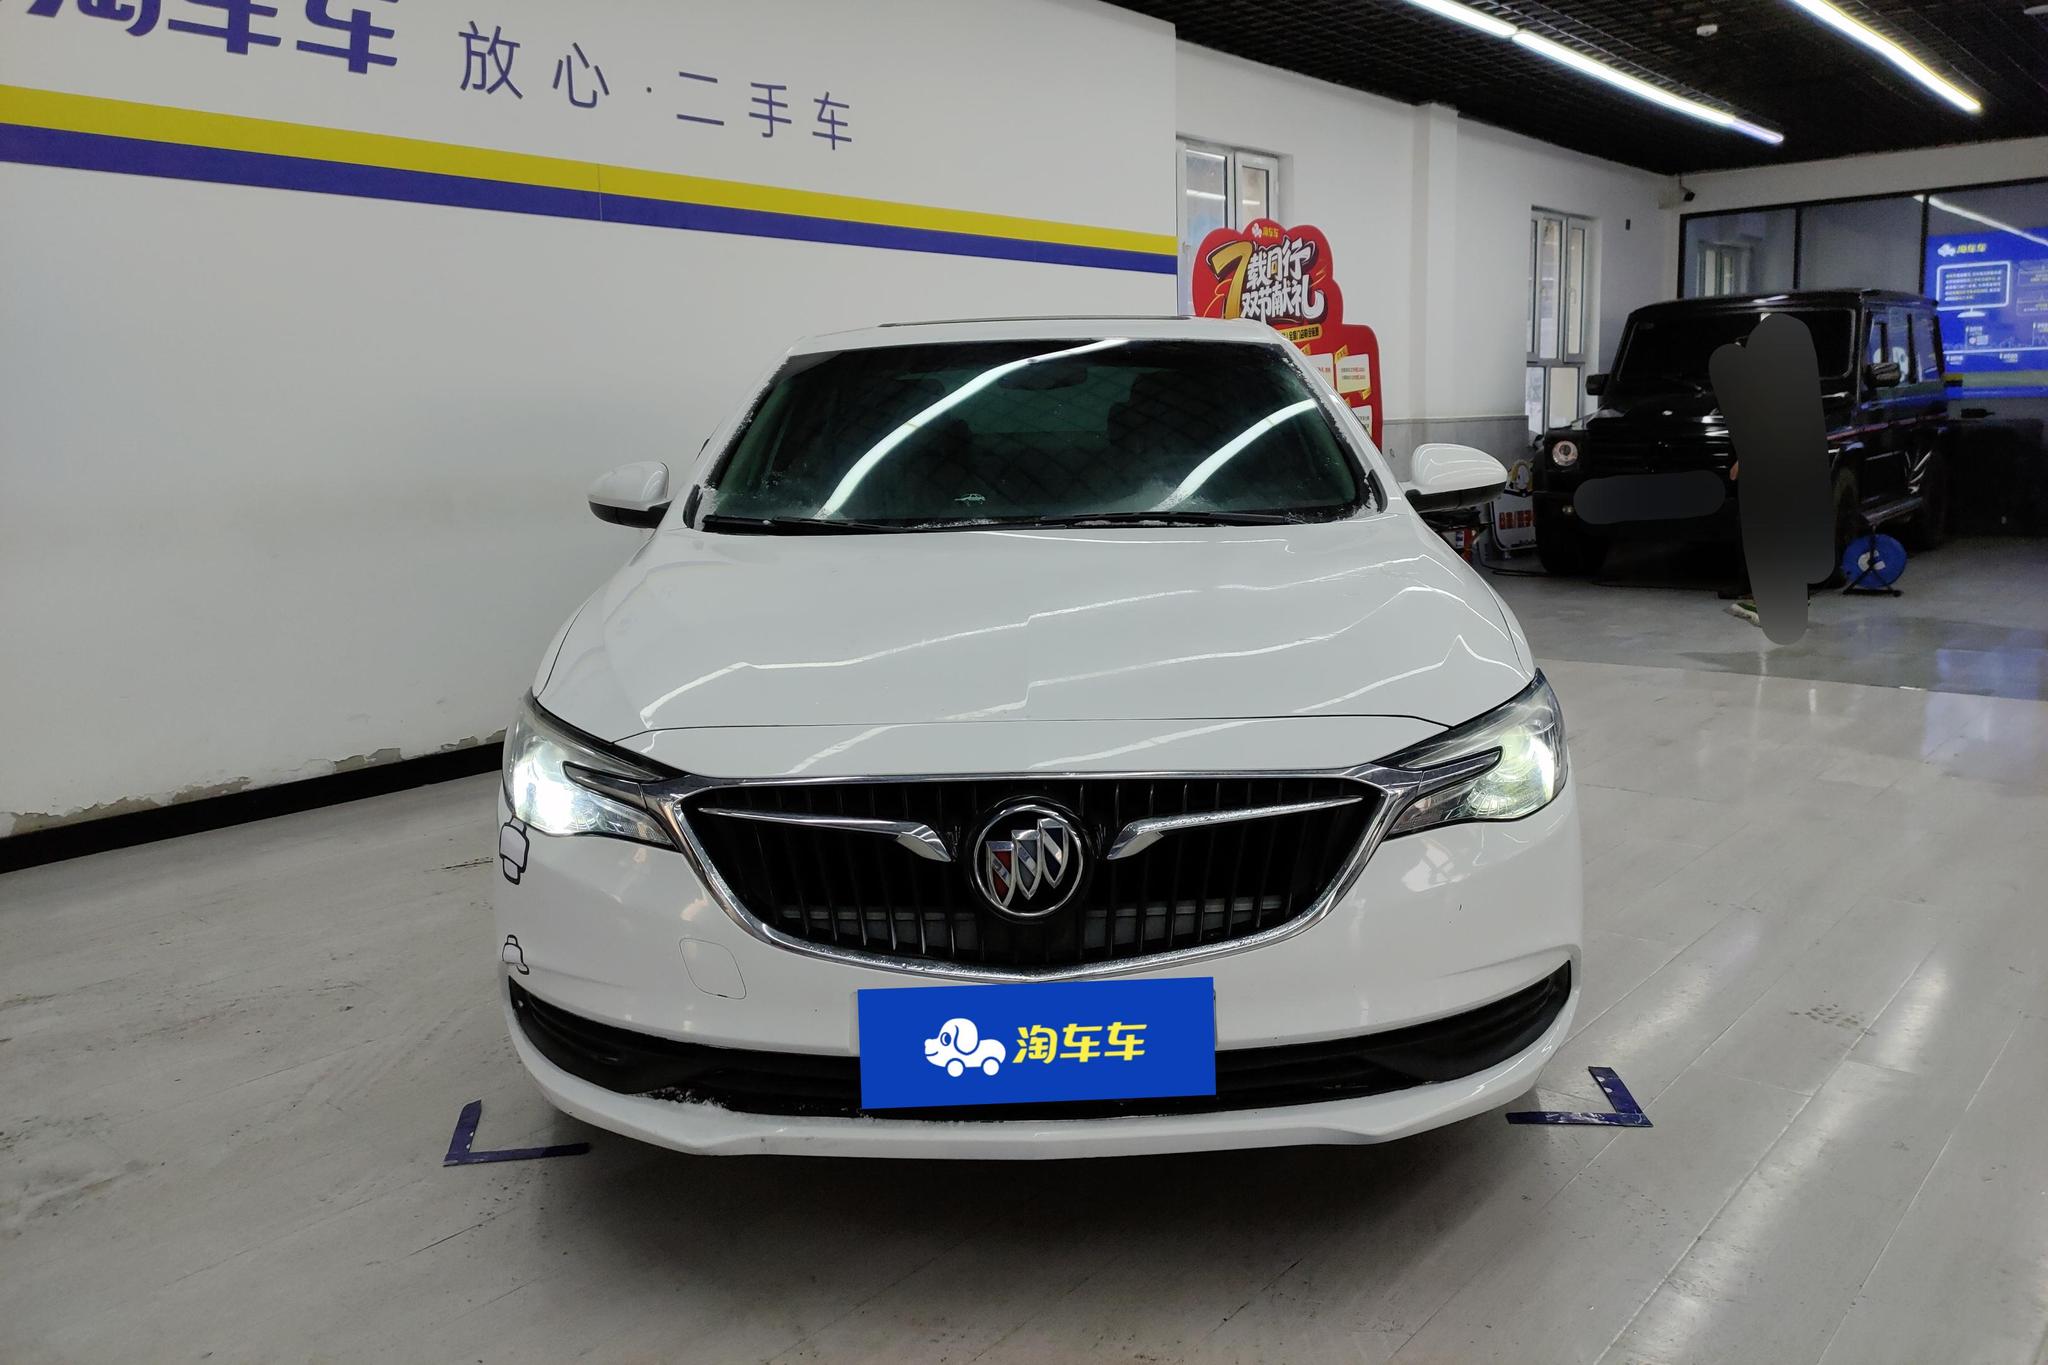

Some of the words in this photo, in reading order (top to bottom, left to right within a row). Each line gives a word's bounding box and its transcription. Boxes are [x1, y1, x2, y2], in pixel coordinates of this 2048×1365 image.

[1246, 237, 1312, 290] 载同行
[1240, 273, 1325, 326] 双节献礼
